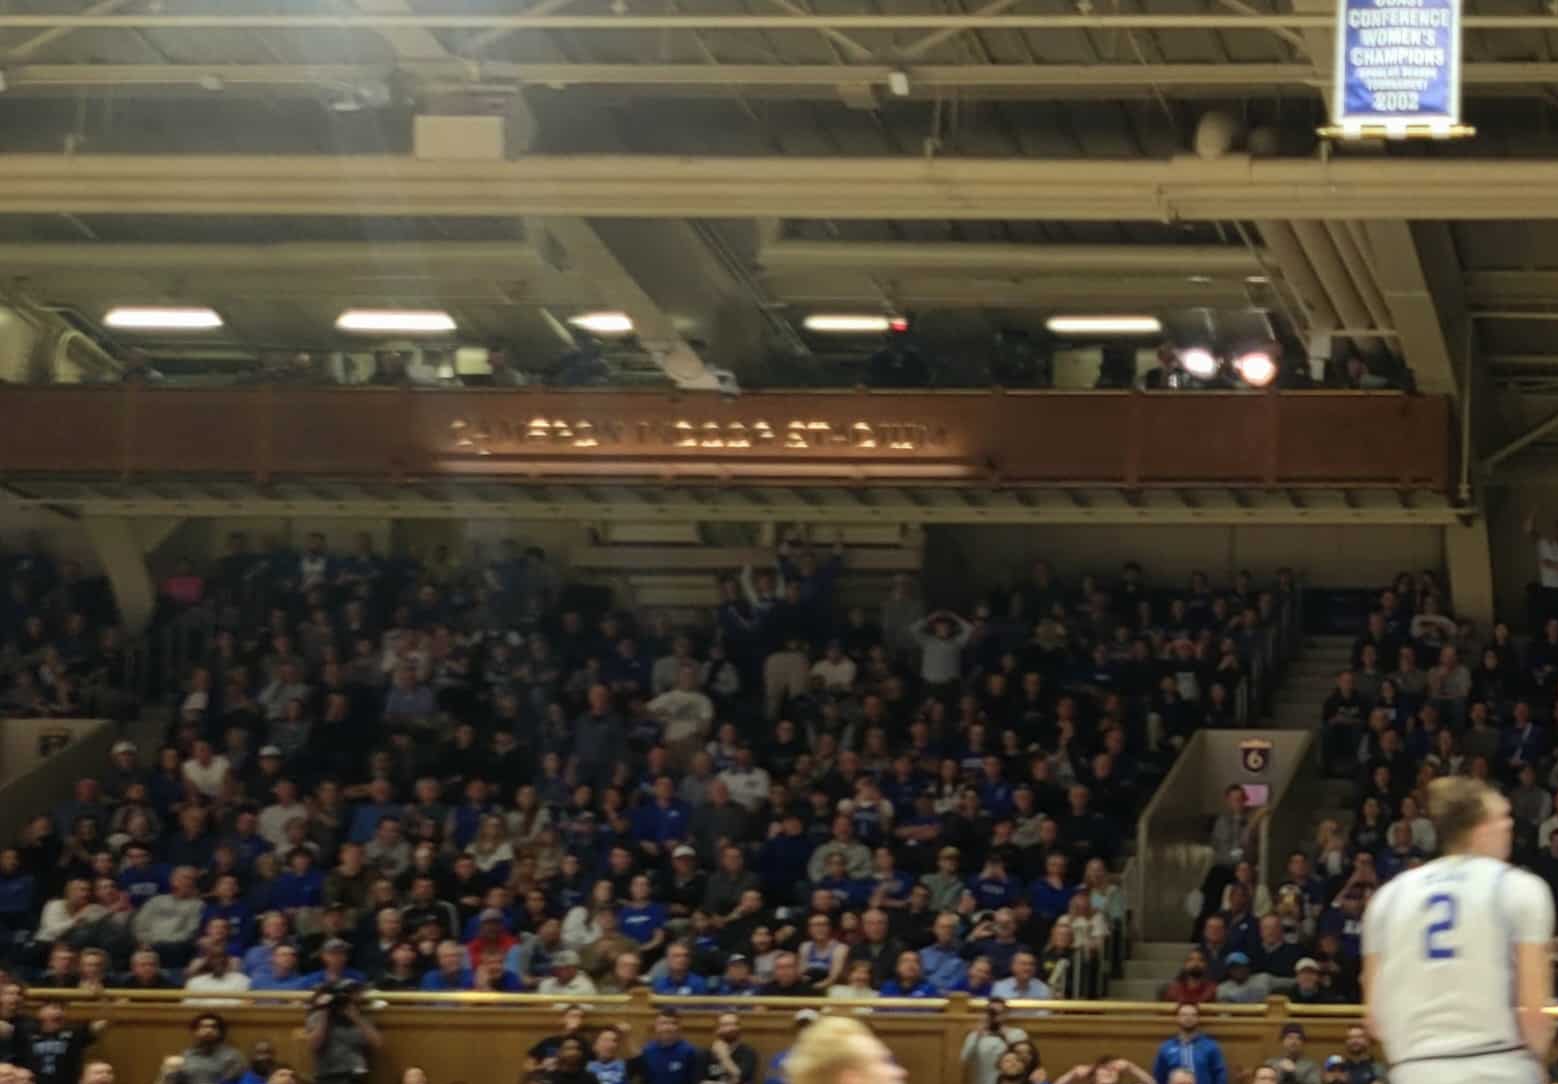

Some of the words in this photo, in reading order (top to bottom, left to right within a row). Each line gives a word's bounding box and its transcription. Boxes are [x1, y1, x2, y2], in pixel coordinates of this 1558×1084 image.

[1348, 8, 1450, 27] CONFERENCE
[1349, 47, 1445, 67] CHAMPIONS
[1426, 894, 1457, 959] 2
